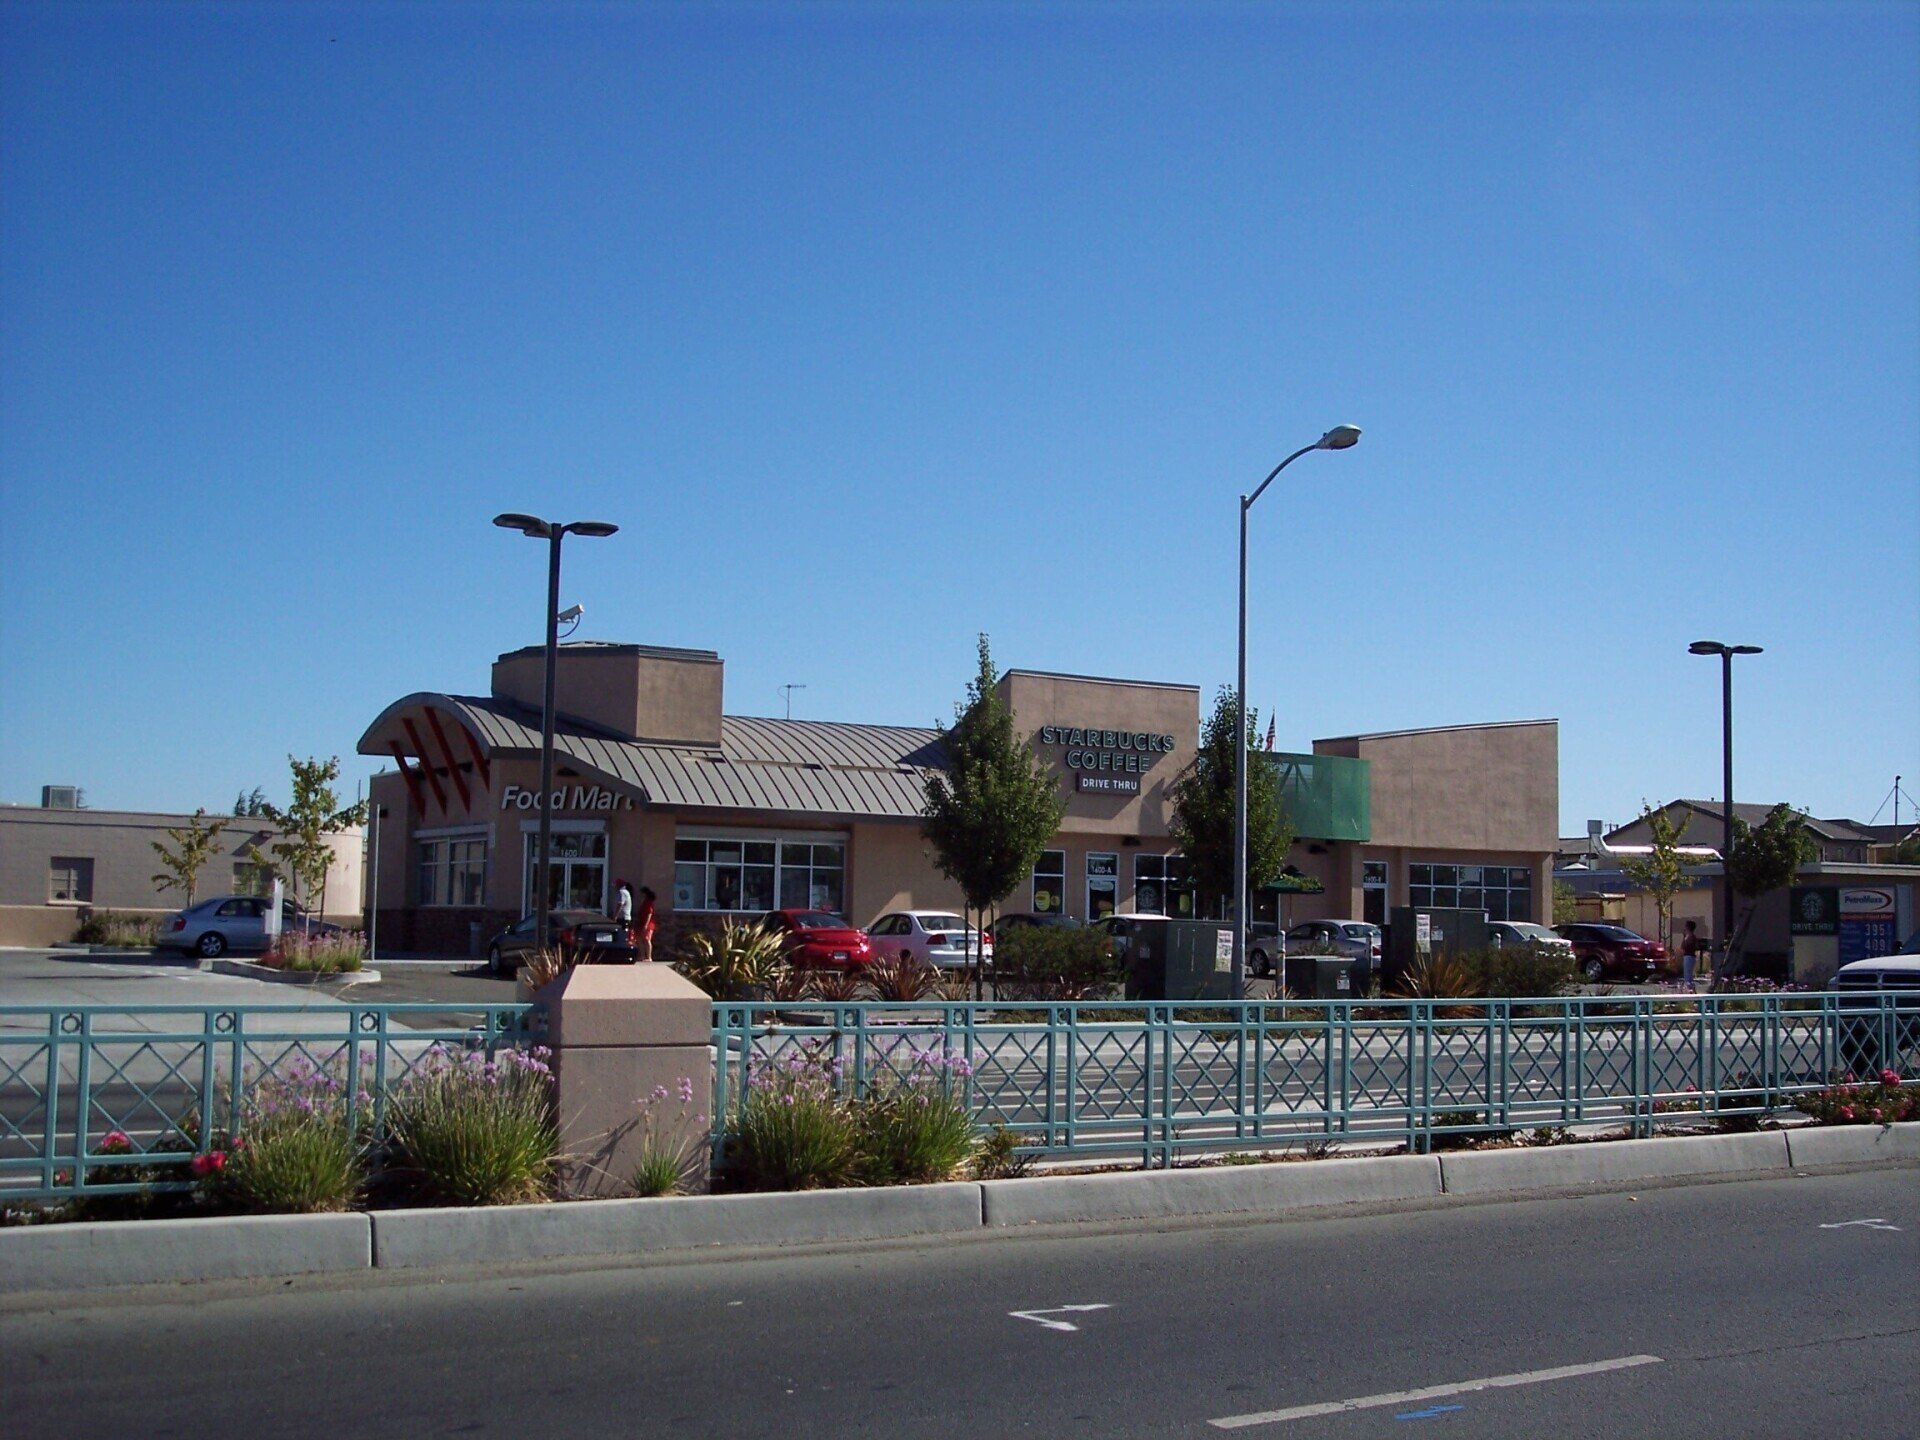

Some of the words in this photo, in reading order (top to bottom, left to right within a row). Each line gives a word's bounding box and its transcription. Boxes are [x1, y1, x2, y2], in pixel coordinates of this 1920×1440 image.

[1042, 725, 1175, 752] STARBUCKS
[1067, 750, 1150, 772] COFFEE
[1082, 778, 1109, 789] DRIVE
[1113, 779, 1137, 790] THRU
